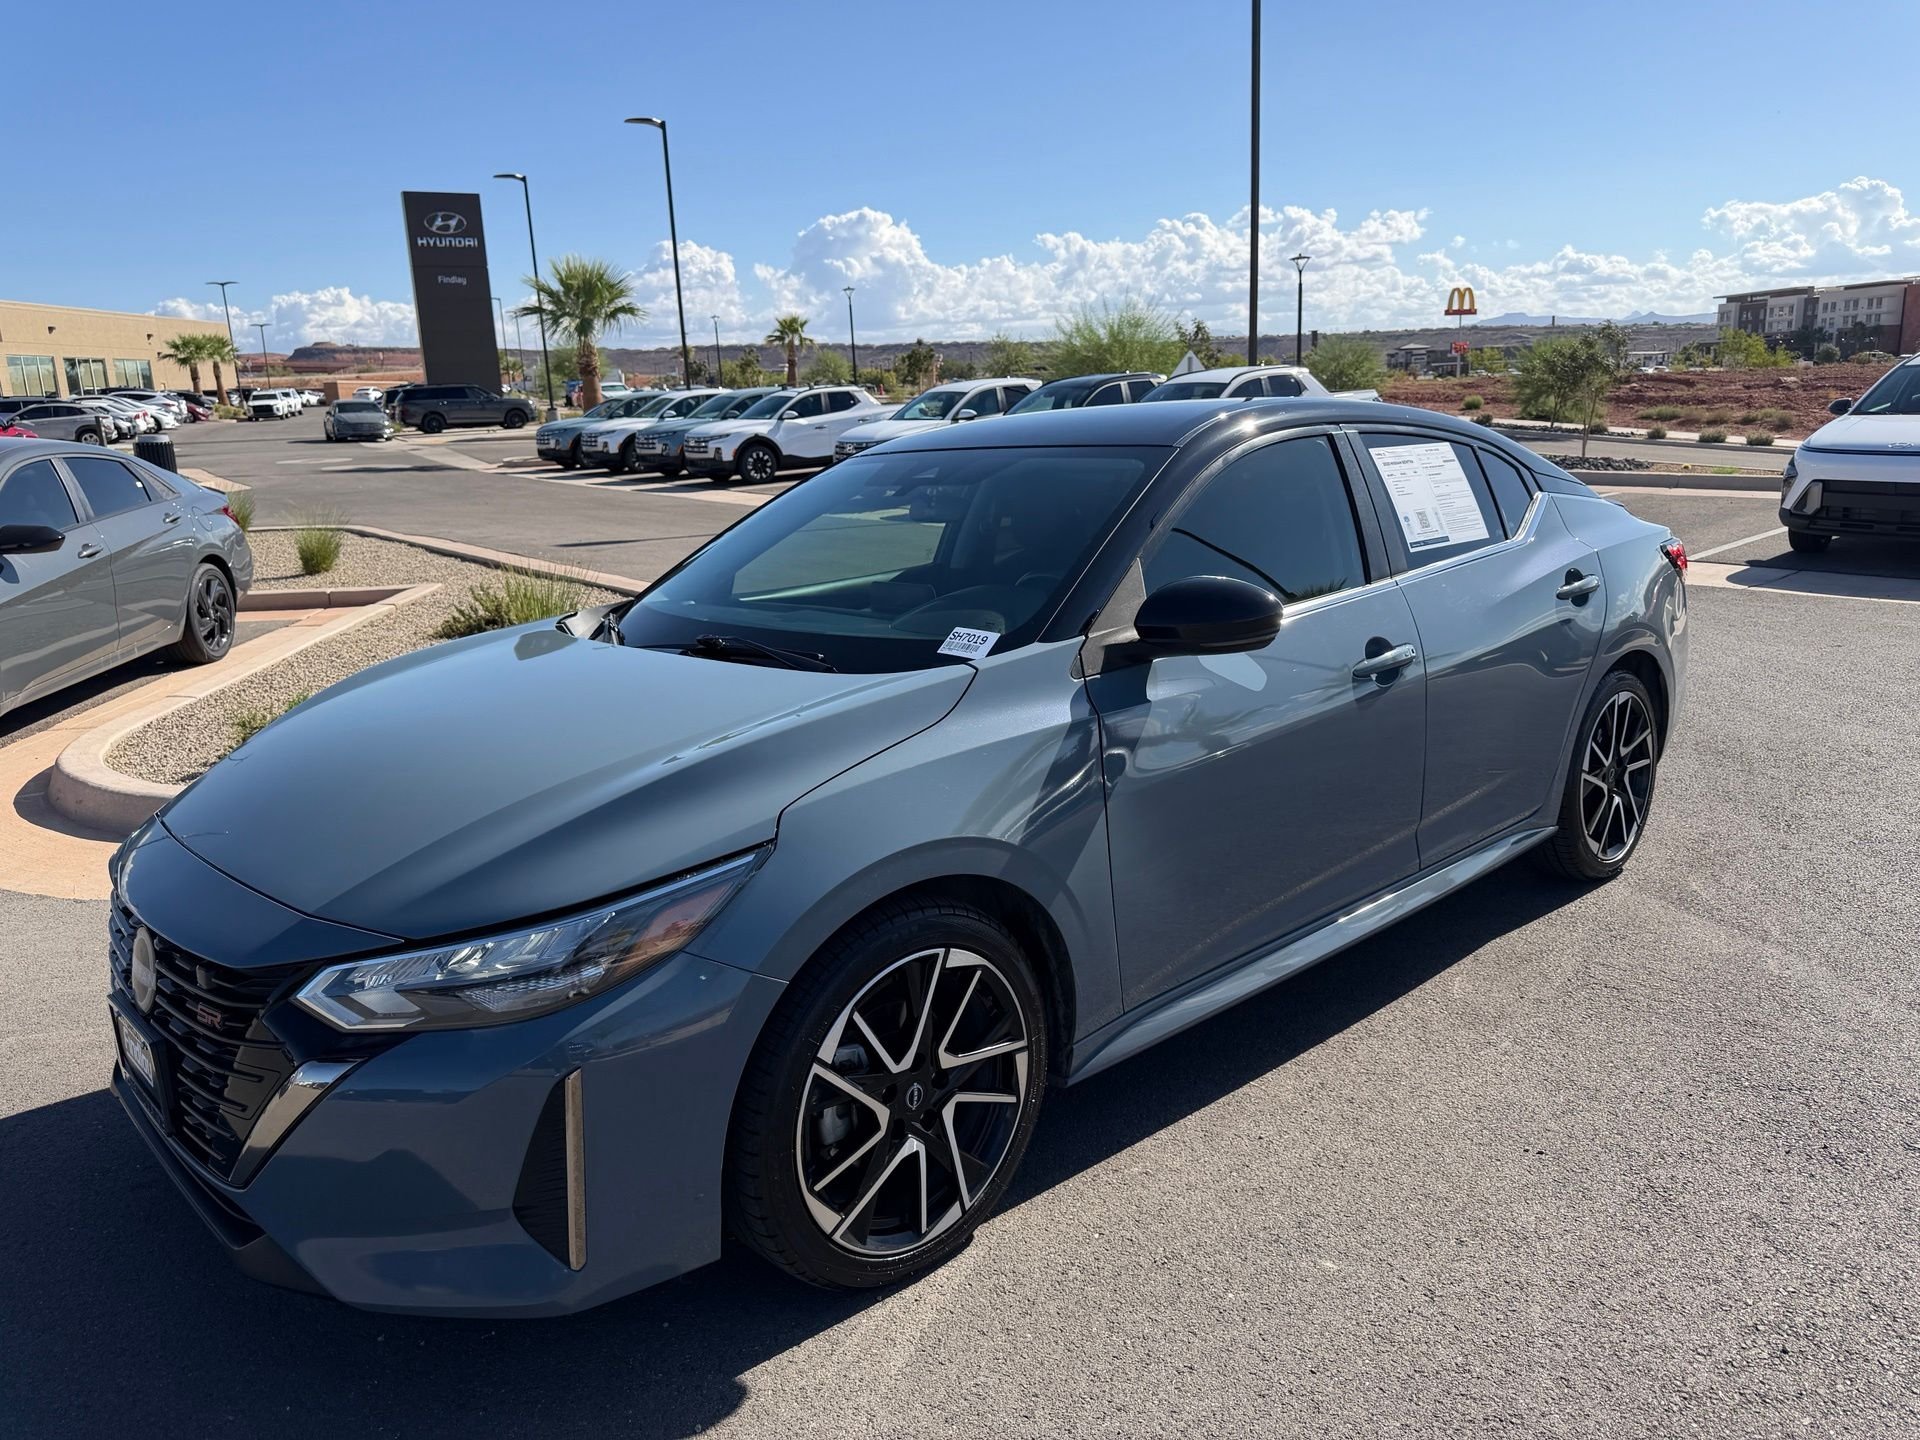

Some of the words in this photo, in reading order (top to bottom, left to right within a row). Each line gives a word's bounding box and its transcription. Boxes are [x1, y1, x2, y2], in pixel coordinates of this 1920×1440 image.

[417, 236, 479, 248] HYUNDAI
[437, 275, 467, 286] Findlay
[949, 631, 989, 646] SH7019
